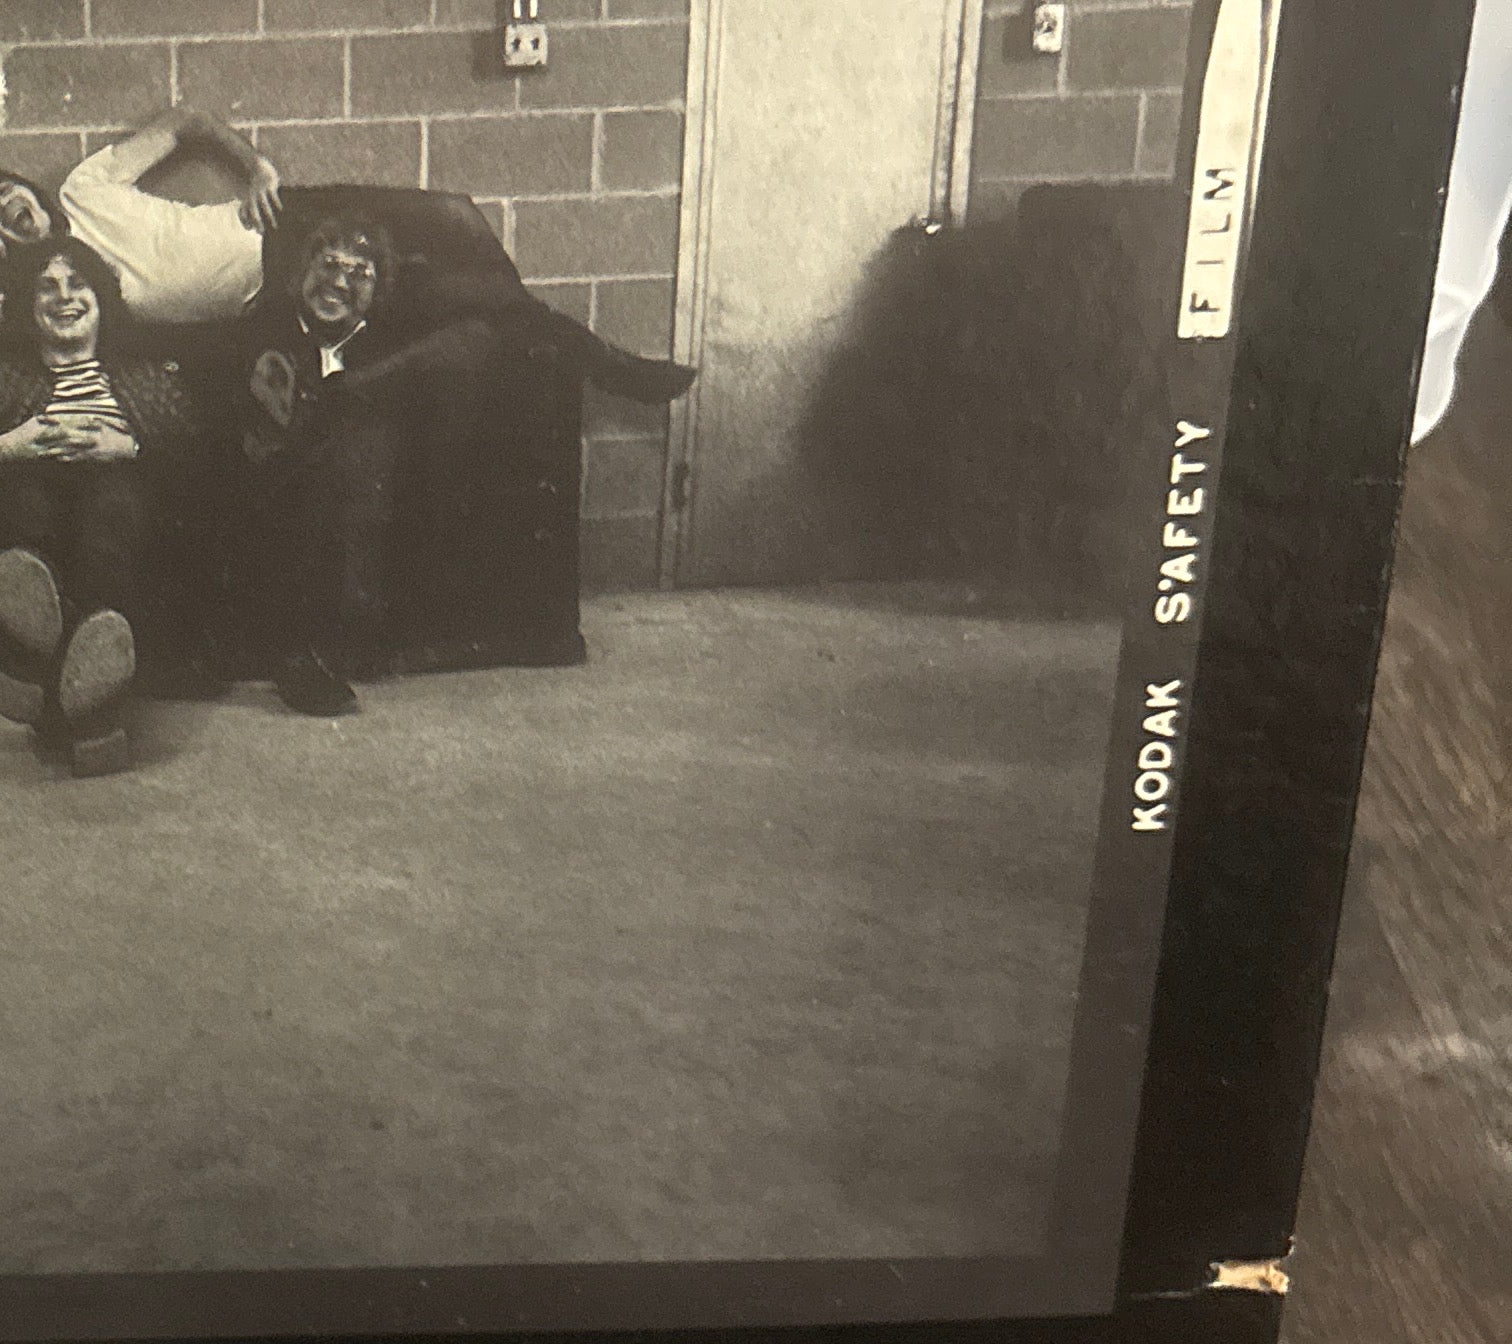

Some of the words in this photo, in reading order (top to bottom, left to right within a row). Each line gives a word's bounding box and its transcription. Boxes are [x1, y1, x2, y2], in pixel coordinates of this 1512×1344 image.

[1188, 166, 1237, 316] FILM
[1154, 419, 1211, 624] SAFETY
[1130, 678, 1182, 833] KODAK
